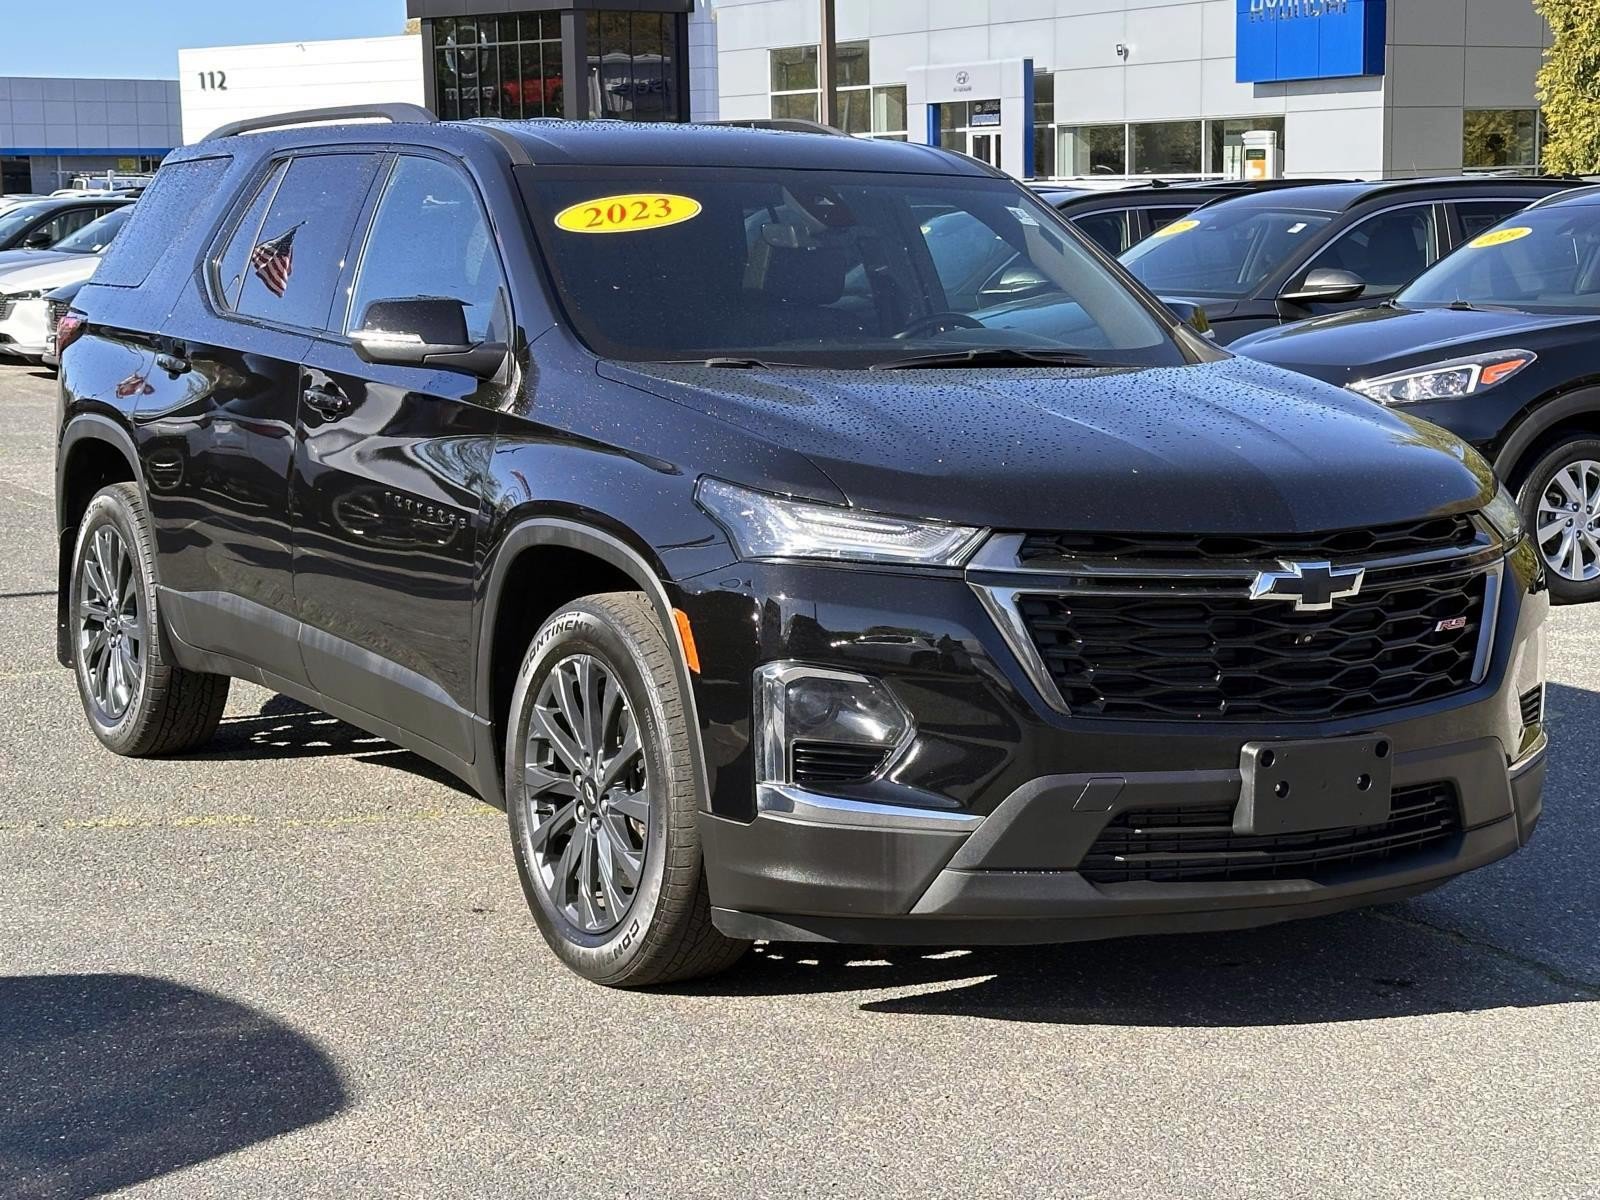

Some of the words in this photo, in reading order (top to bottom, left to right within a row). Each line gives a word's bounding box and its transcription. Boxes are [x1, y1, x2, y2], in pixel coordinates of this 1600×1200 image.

[198, 70, 228, 92] 112
[583, 198, 673, 228] 2023
[1434, 615, 1468, 632] RS
[522, 619, 602, 679] CONTINENT
